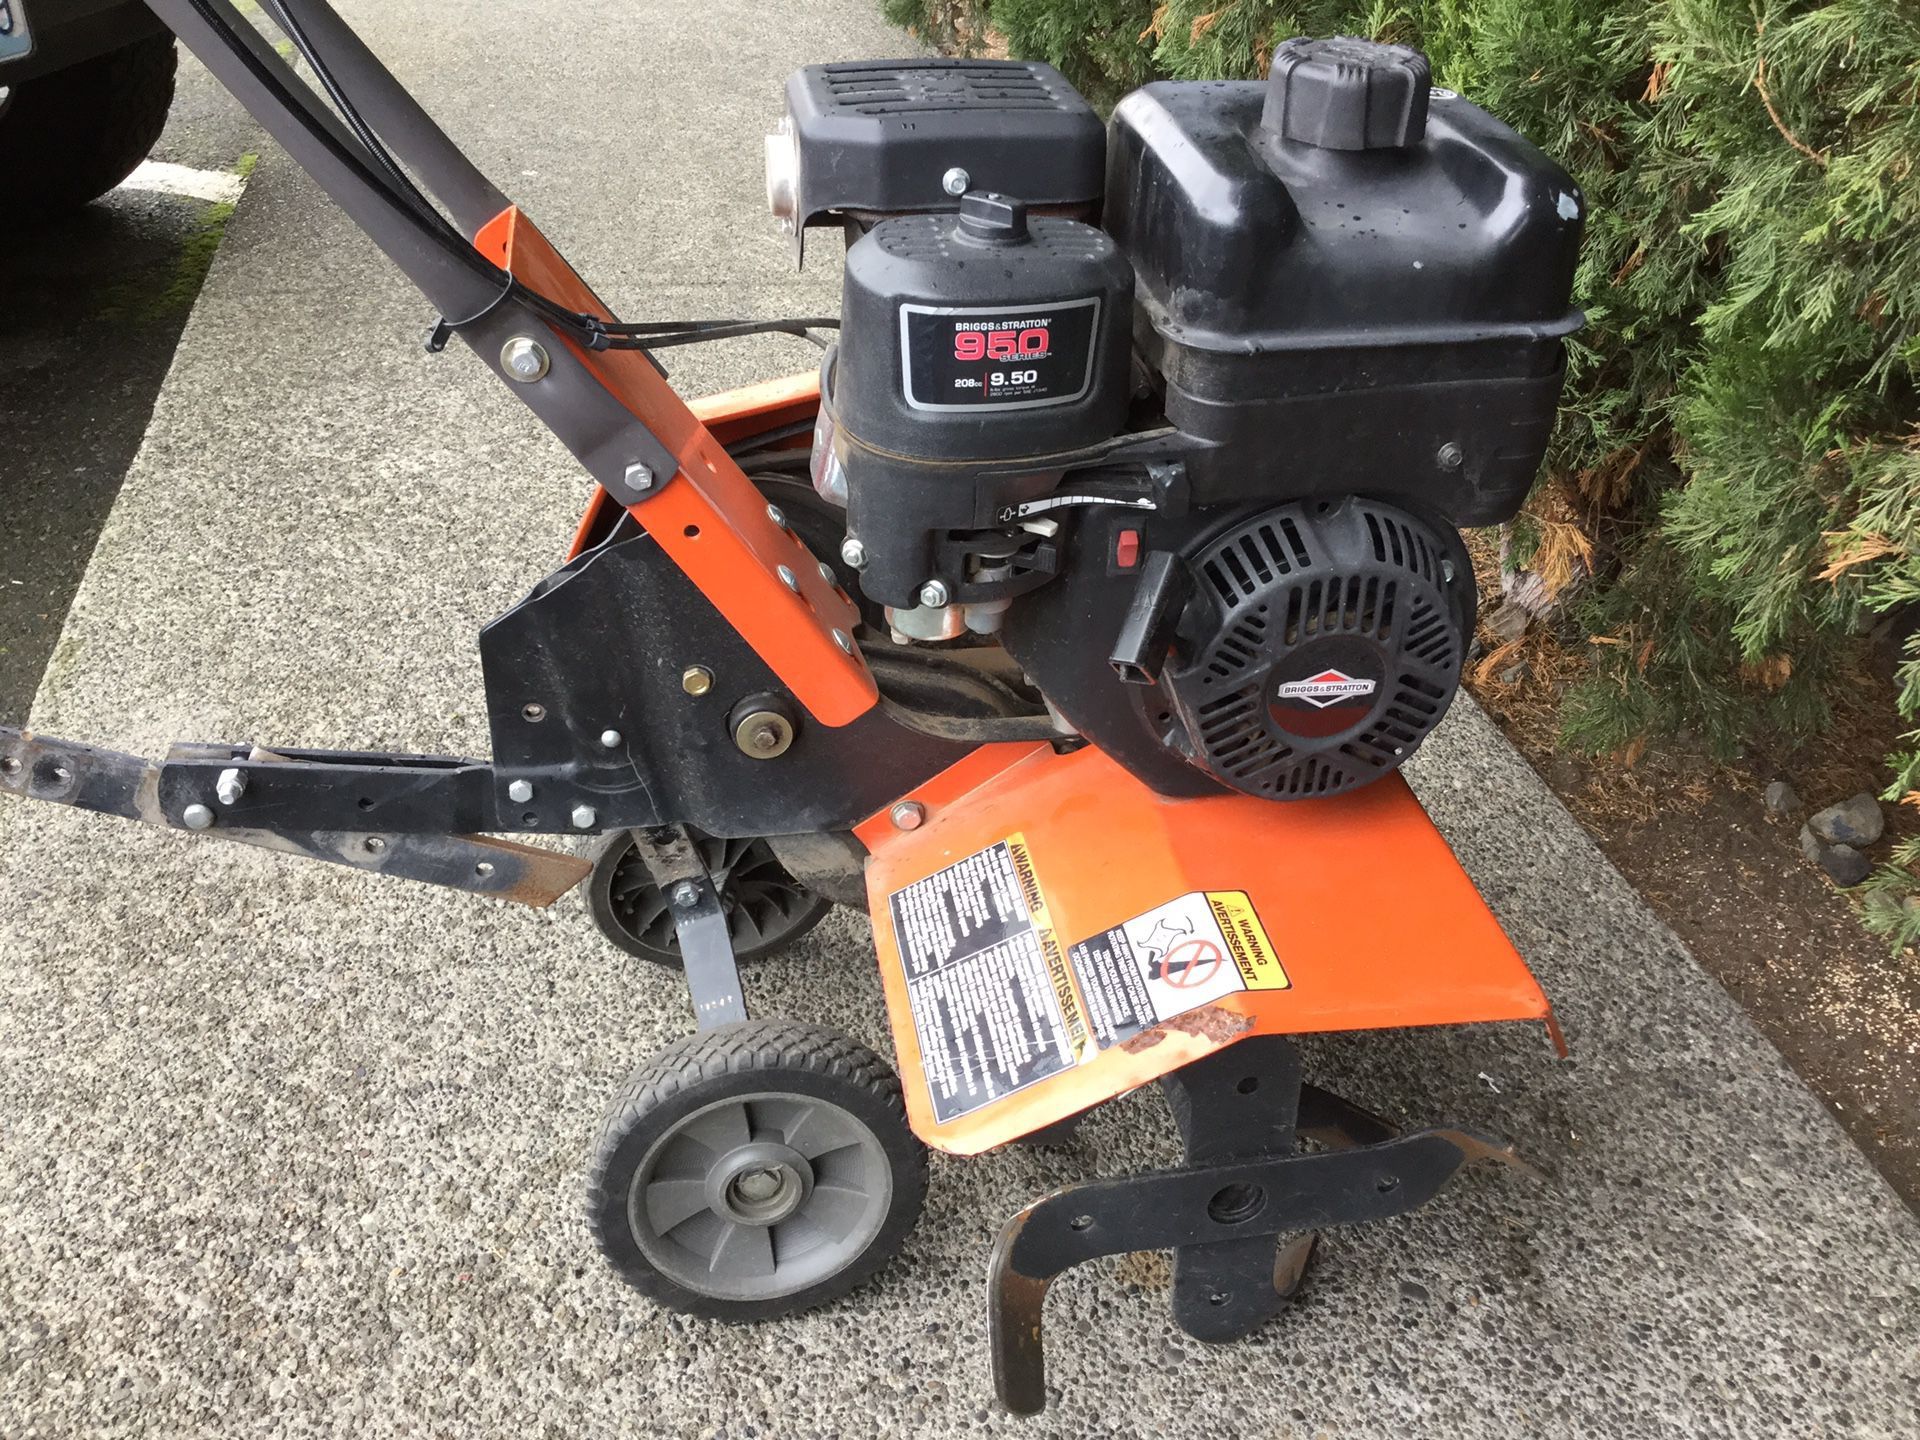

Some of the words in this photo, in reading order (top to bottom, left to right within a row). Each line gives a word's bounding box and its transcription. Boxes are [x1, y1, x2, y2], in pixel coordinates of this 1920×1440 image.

[954, 328, 1049, 360] 950
[1000, 352, 1047, 362] SERIES
[955, 379, 983, 388] 208cc
[991, 370, 1038, 386] 9.50
[1013, 850, 1043, 912] WARNING
[1211, 901, 1257, 980] AVERTISSEMENT
[1238, 918, 1268, 966] WARNING
